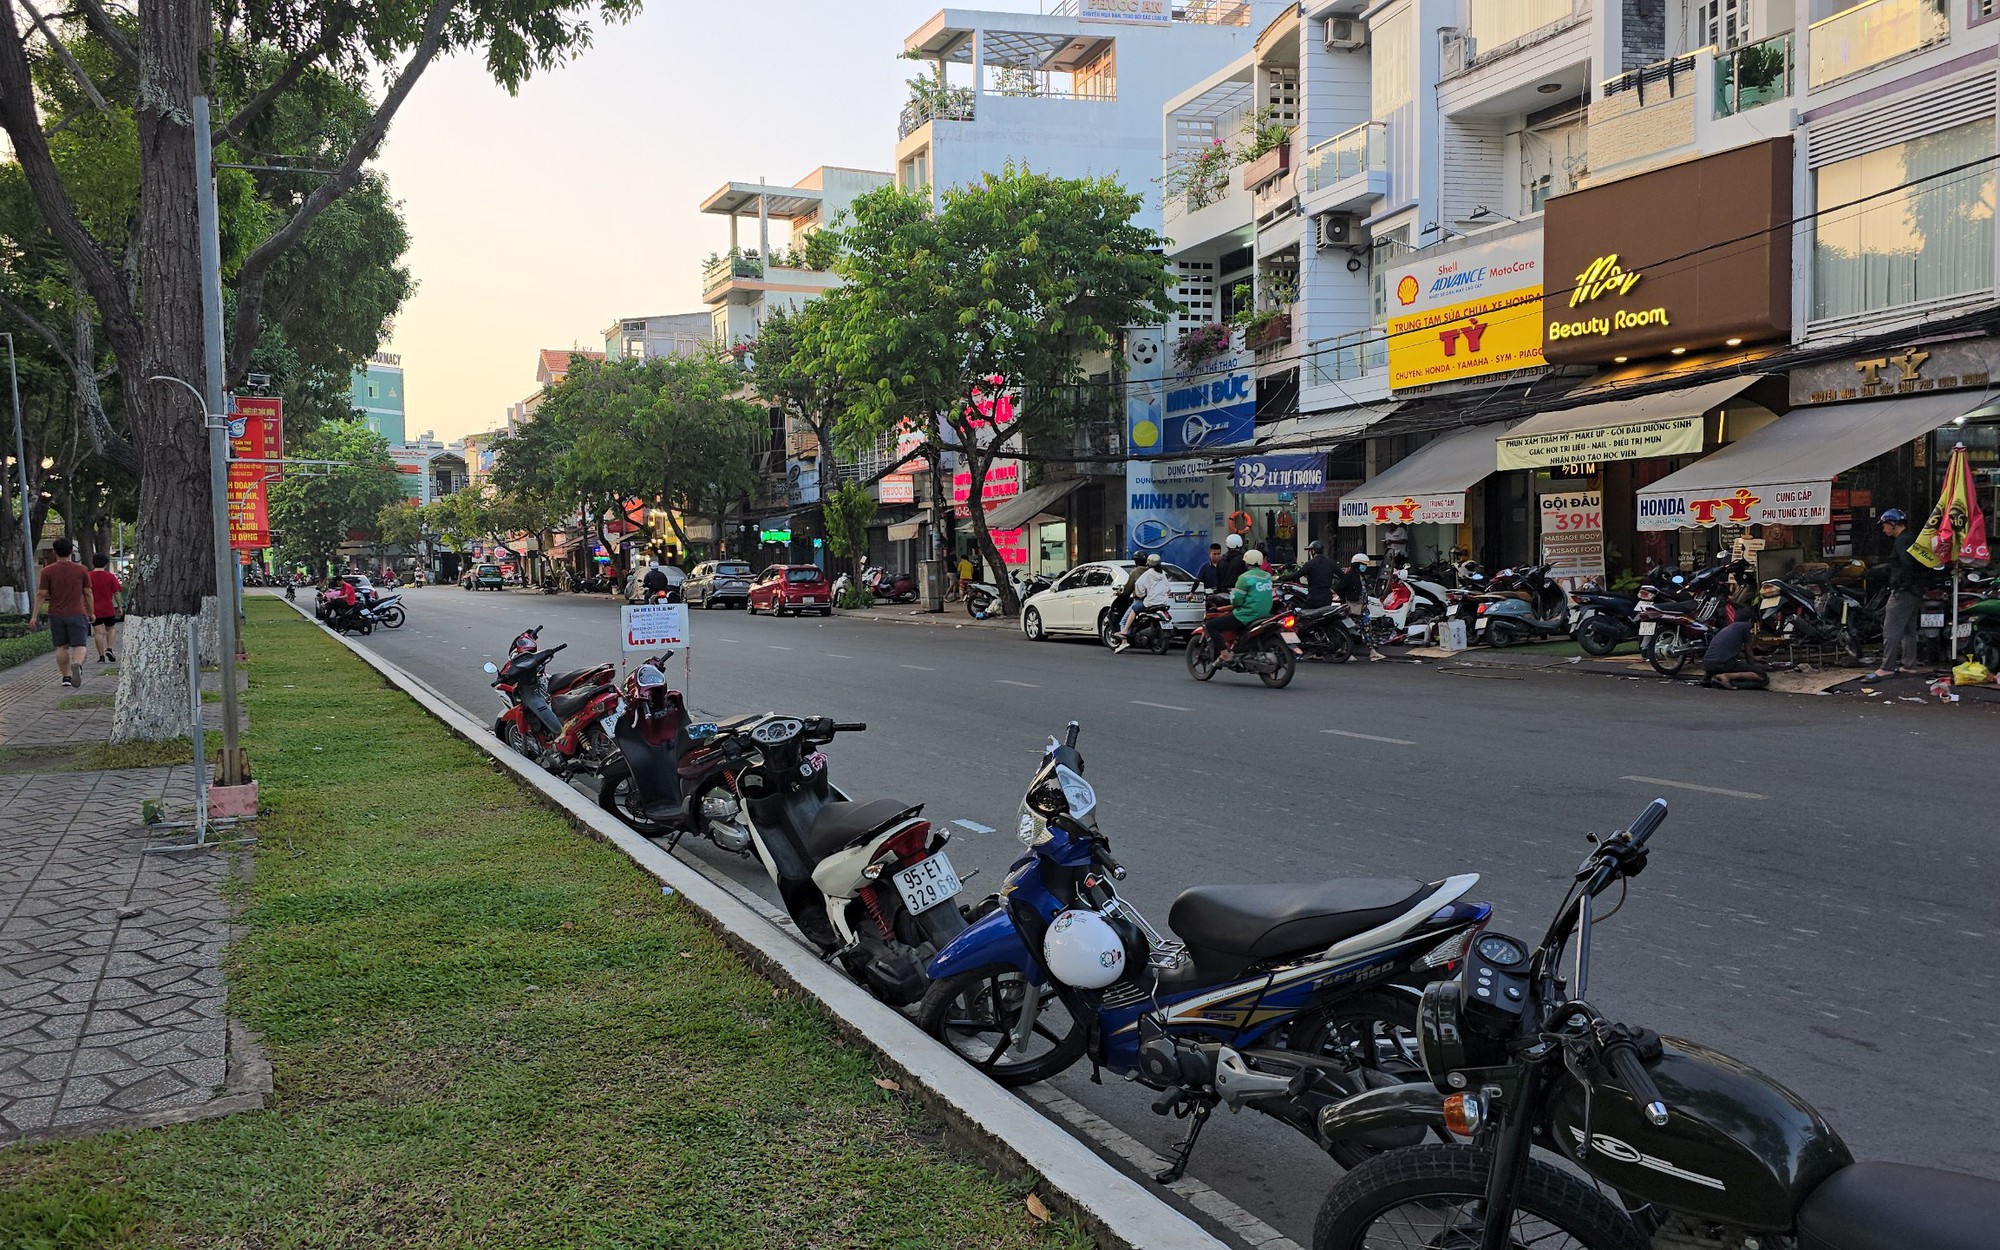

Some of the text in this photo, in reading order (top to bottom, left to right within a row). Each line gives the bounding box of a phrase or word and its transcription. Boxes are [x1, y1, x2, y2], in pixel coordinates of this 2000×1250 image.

[1141, 1, 1163, 13] AN
[1429, 260, 1535, 293] ADVANCE MotoCare
[1438, 261, 1457, 276] Shell
[1395, 319, 1422, 334] TRUNG
[1424, 314, 1441, 326] TÂM
[1506, 293, 1543, 307] HONDA
[1549, 307, 1669, 340] Beauty Room
[1219, 357, 1238, 370] THAO
[1425, 364, 1451, 376] HONDA
[1457, 357, 1489, 370] YAMAHA
[1496, 353, 1512, 364] SYM
[1166, 372, 1250, 414] MINH ĐỨC
[1505, 440, 1523, 448] PHUN
[1575, 430, 1595, 440] MAKE
[1595, 429, 1605, 438] UP
[1672, 419, 1692, 430] SINH
[1591, 440, 1607, 450] NAIL
[1644, 435, 1662, 445] MỤN
[1603, 451, 1619, 460] HỌC
[1168, 464, 1187, 478] DỤNG
[1187, 462, 1197, 479] CỤ
[1239, 462, 1322, 489] 32 LÝ TỰ TRỌNG
[1570, 462, 1595, 475] DIM
[234, 481, 259, 490] DOANH
[904, 486, 912, 496] AN
[1131, 489, 1210, 510] MINH ĐỨC
[1542, 492, 1600, 511] GỘI ĐẦU
[1775, 486, 1812, 503] CUNG CẤP
[1341, 501, 1369, 517] HONDA
[1640, 497, 1686, 517] HONDA
[1798, 507, 1808, 517] XE
[1810, 504, 1826, 517] MÁY
[243, 512, 255, 521] TIN
[1555, 512, 1601, 531] 39K
[238, 531, 258, 541] DÙNG
[1544, 532, 1600, 542] MASSAGE BODY
[1581, 545, 1601, 553] FOOT
